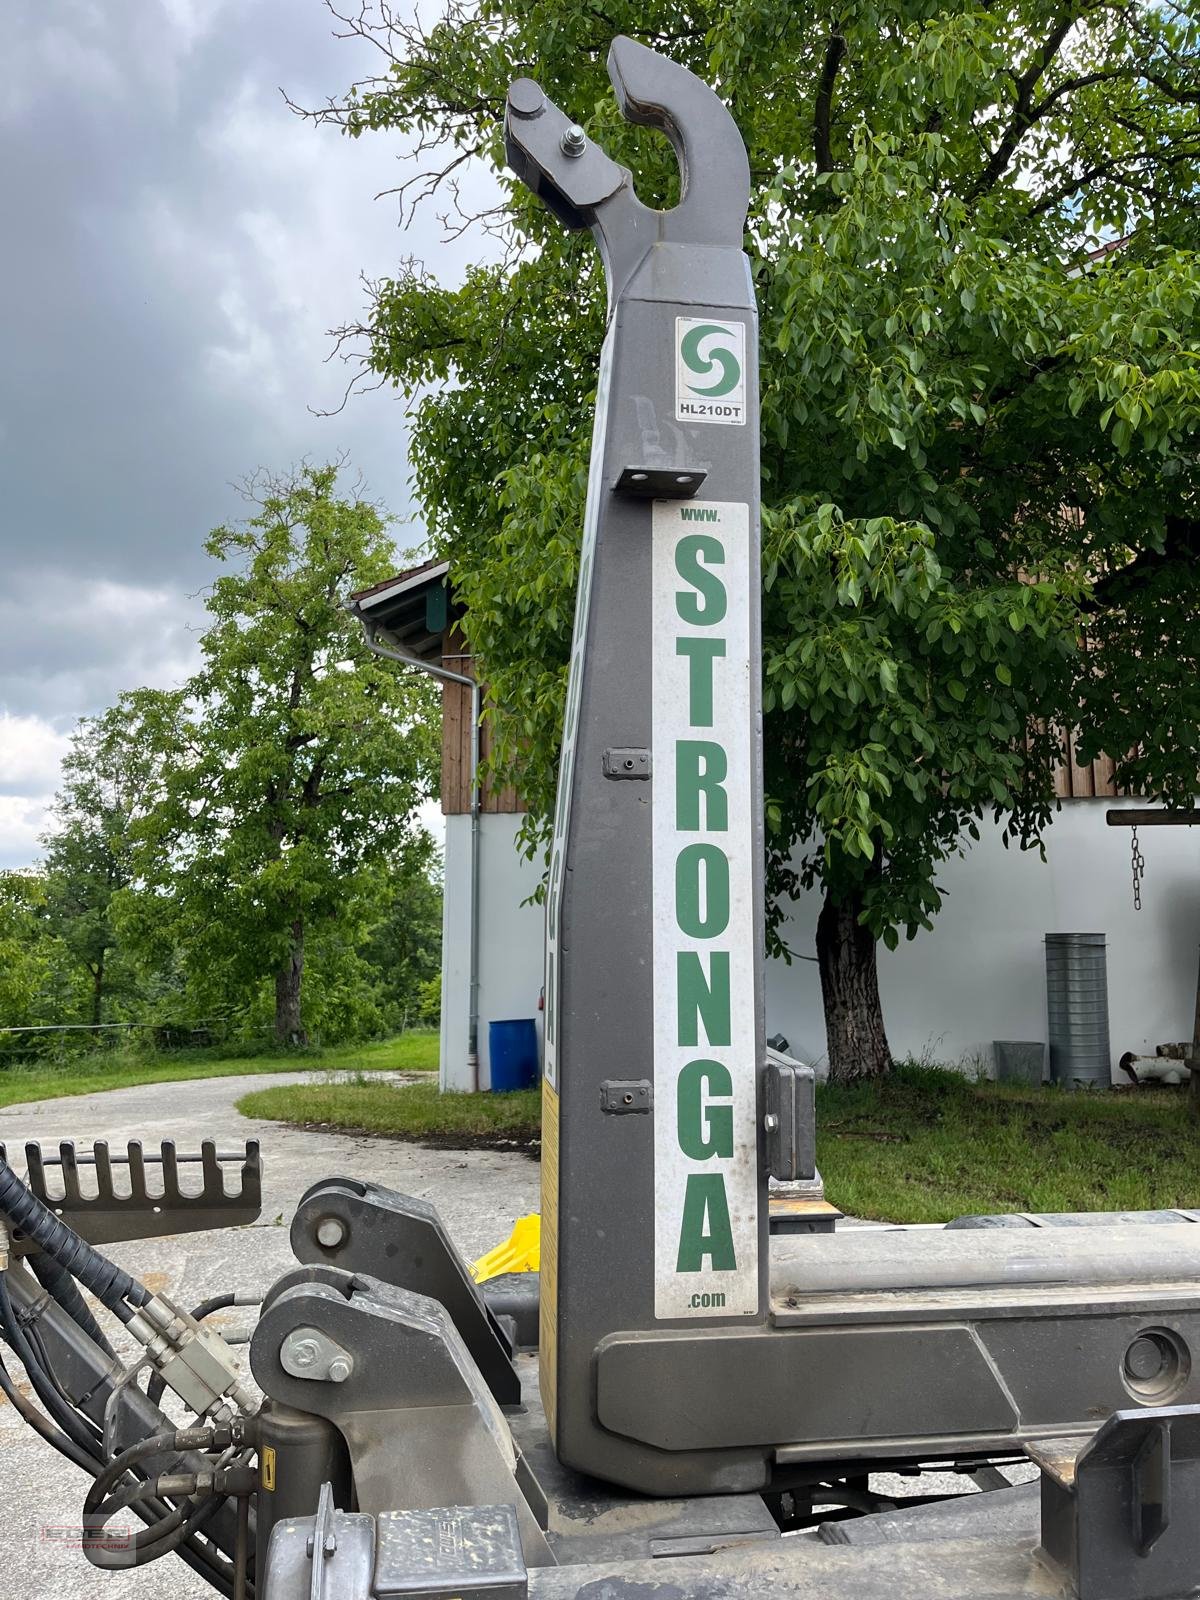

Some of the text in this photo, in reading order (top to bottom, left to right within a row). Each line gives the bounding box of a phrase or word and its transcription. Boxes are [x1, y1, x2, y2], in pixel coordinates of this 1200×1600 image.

[680, 404, 741, 417] HL210DT
[680, 507, 721, 523] www.
[674, 534, 738, 1273] STRONGA
[687, 1292, 726, 1308] .com
